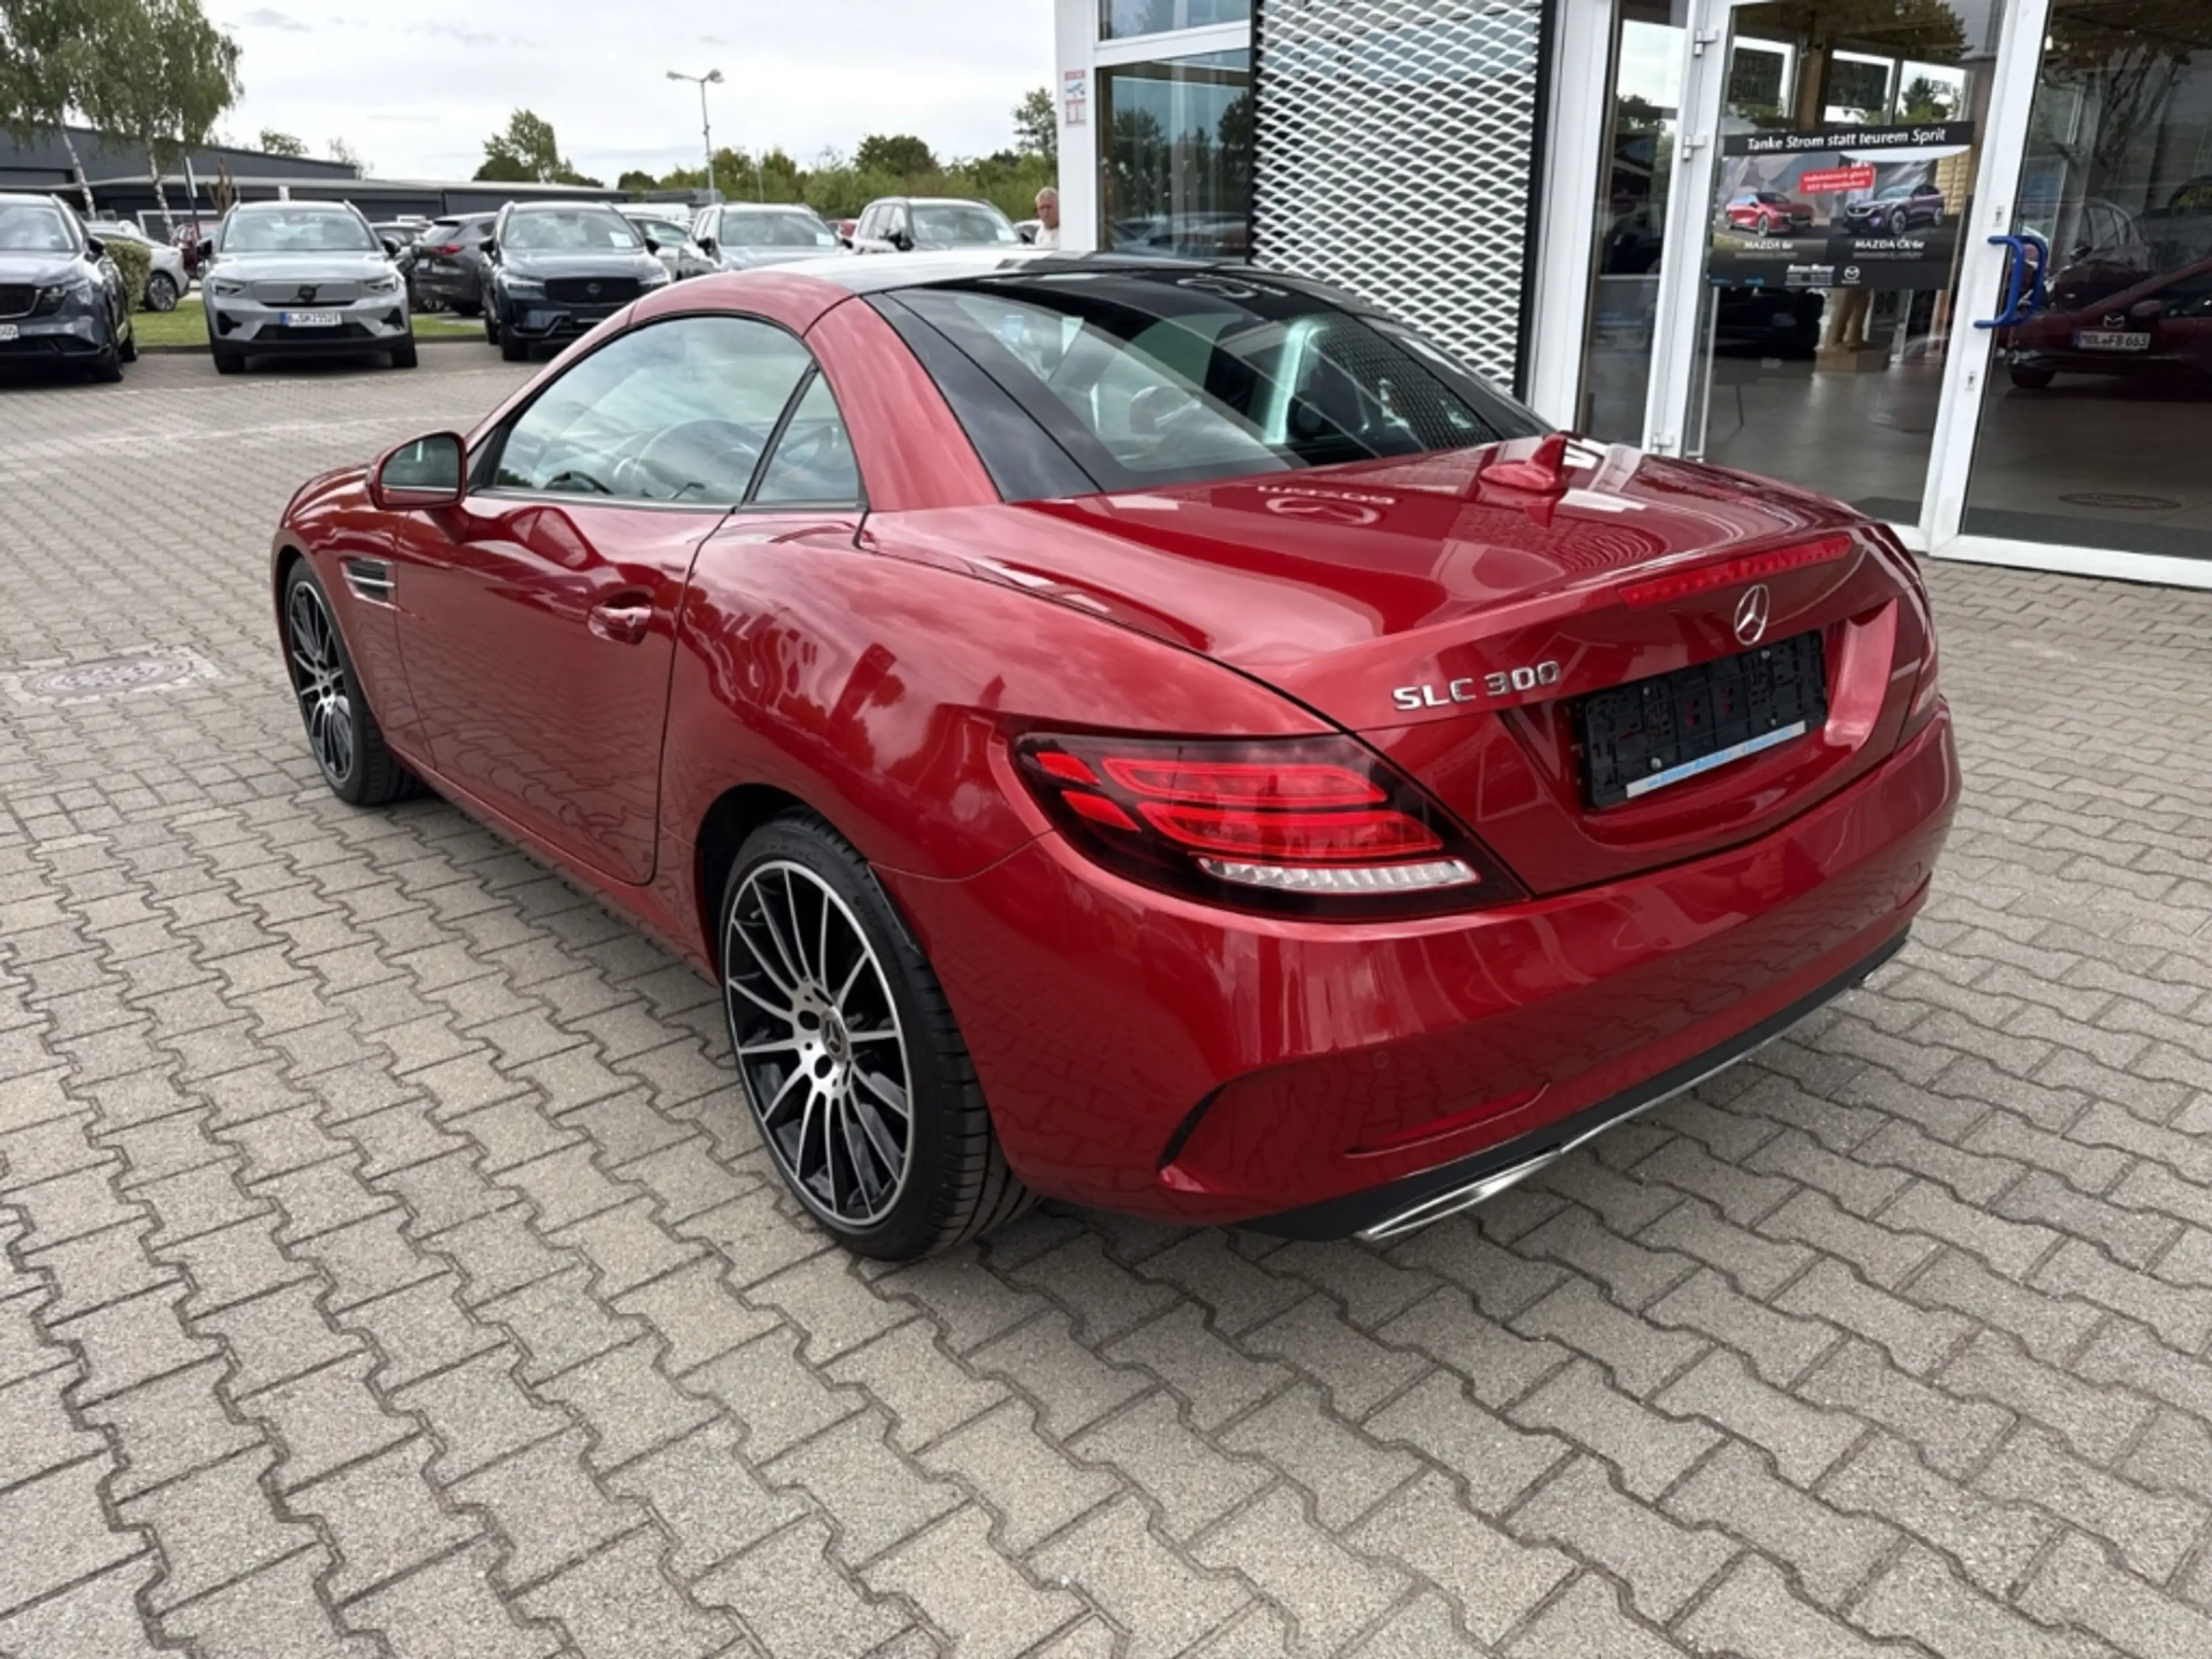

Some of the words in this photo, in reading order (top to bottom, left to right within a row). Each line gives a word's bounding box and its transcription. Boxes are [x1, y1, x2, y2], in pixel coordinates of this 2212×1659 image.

[1747, 136, 1783, 150] Tanke
[1786, 134, 1824, 148] Strom
[1827, 133, 1856, 146] statt
[1859, 131, 1908, 145] teurem
[1911, 127, 1947, 145] Sprit
[1744, 240, 1780, 249] MAZDA
[1854, 239, 1895, 249] MAZDA
[1392, 677, 1478, 711] SLC
[1483, 660, 1560, 697] 300
